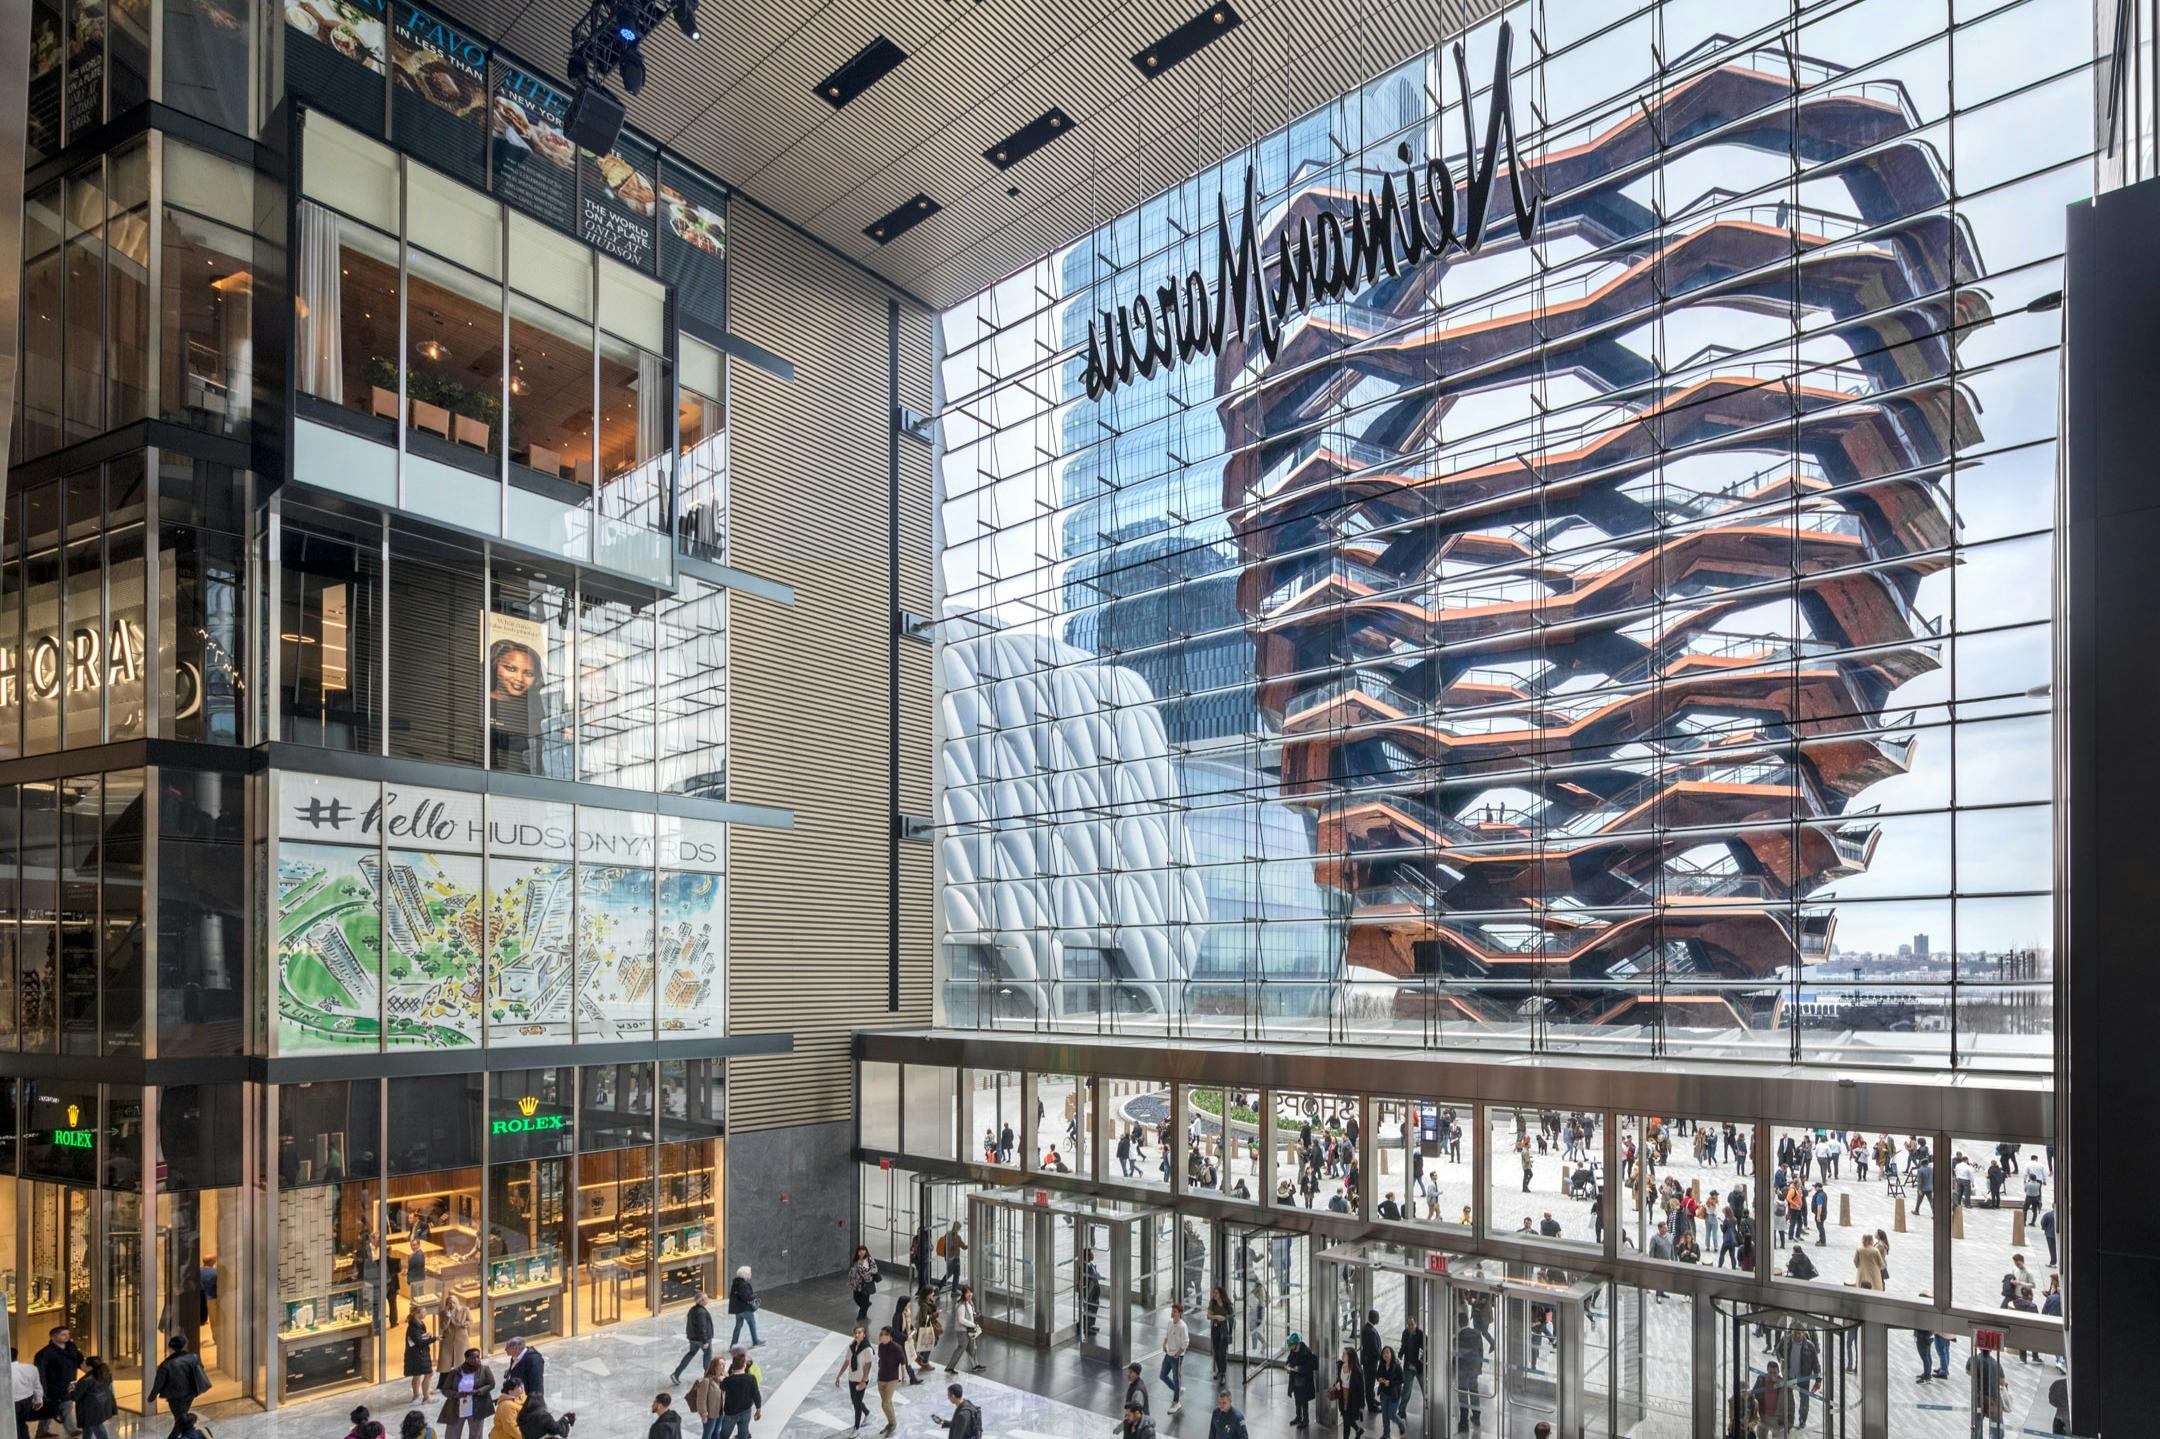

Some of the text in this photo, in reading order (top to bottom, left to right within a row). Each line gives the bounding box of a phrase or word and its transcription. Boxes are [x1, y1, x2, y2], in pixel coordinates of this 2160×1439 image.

[396, 25, 483, 81] IN LESS THAN
[508, 91, 564, 127] NEW YOR
[584, 209, 651, 250] ON A PLATE.
[585, 198, 649, 238] THE WORLD
[584, 220, 642, 253] ONLY AT
[585, 231, 642, 265] HUDSON
[55, 1130, 92, 1148] ROLEX
[492, 1115, 564, 1135] ROLEX
[1430, 1254, 1446, 1272] EXIT
[1976, 1328, 2001, 1350] EXIT
